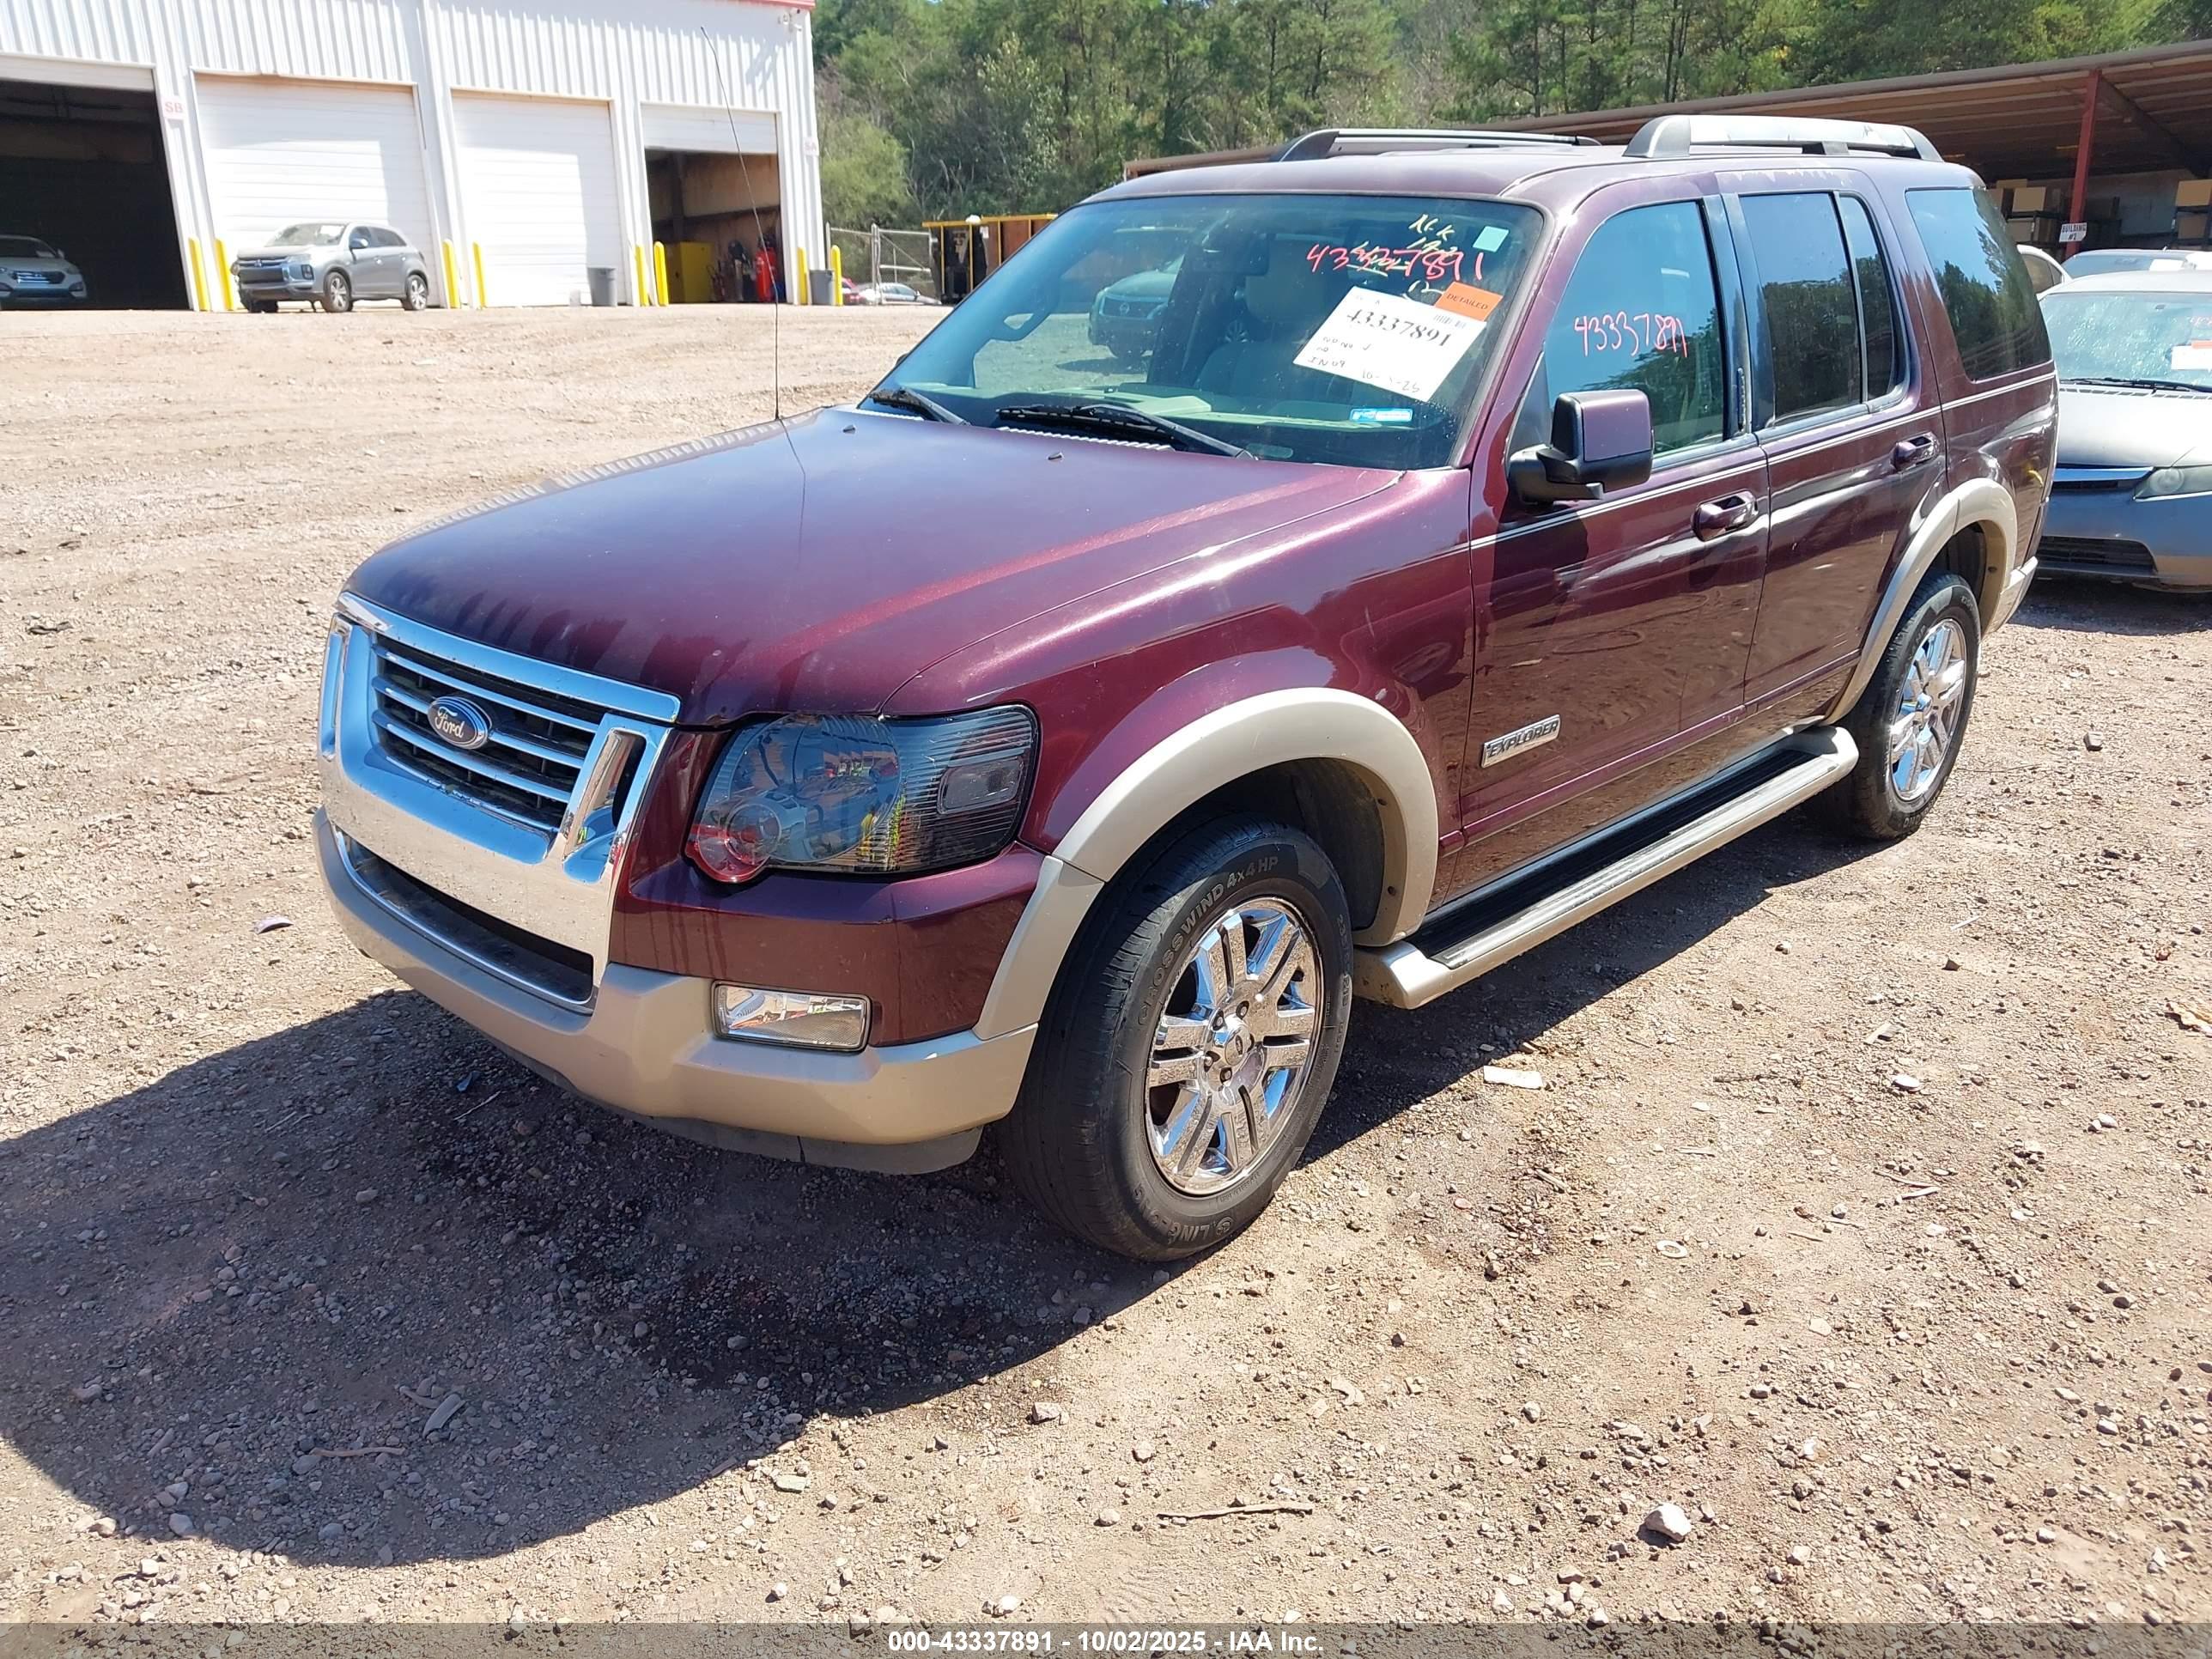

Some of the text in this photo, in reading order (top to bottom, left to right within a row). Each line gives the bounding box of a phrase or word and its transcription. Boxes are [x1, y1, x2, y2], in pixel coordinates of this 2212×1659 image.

[1446, 293, 1488, 310] DETAILED
[1346, 308, 1451, 347] 43337891
[1574, 311, 1687, 358] 43337891
[434, 706, 465, 738] Ford
[1486, 720, 1559, 758] EXPLORER
[1137, 883, 1224, 1026] CROSSWIND
[1258, 855, 1279, 873] HP
